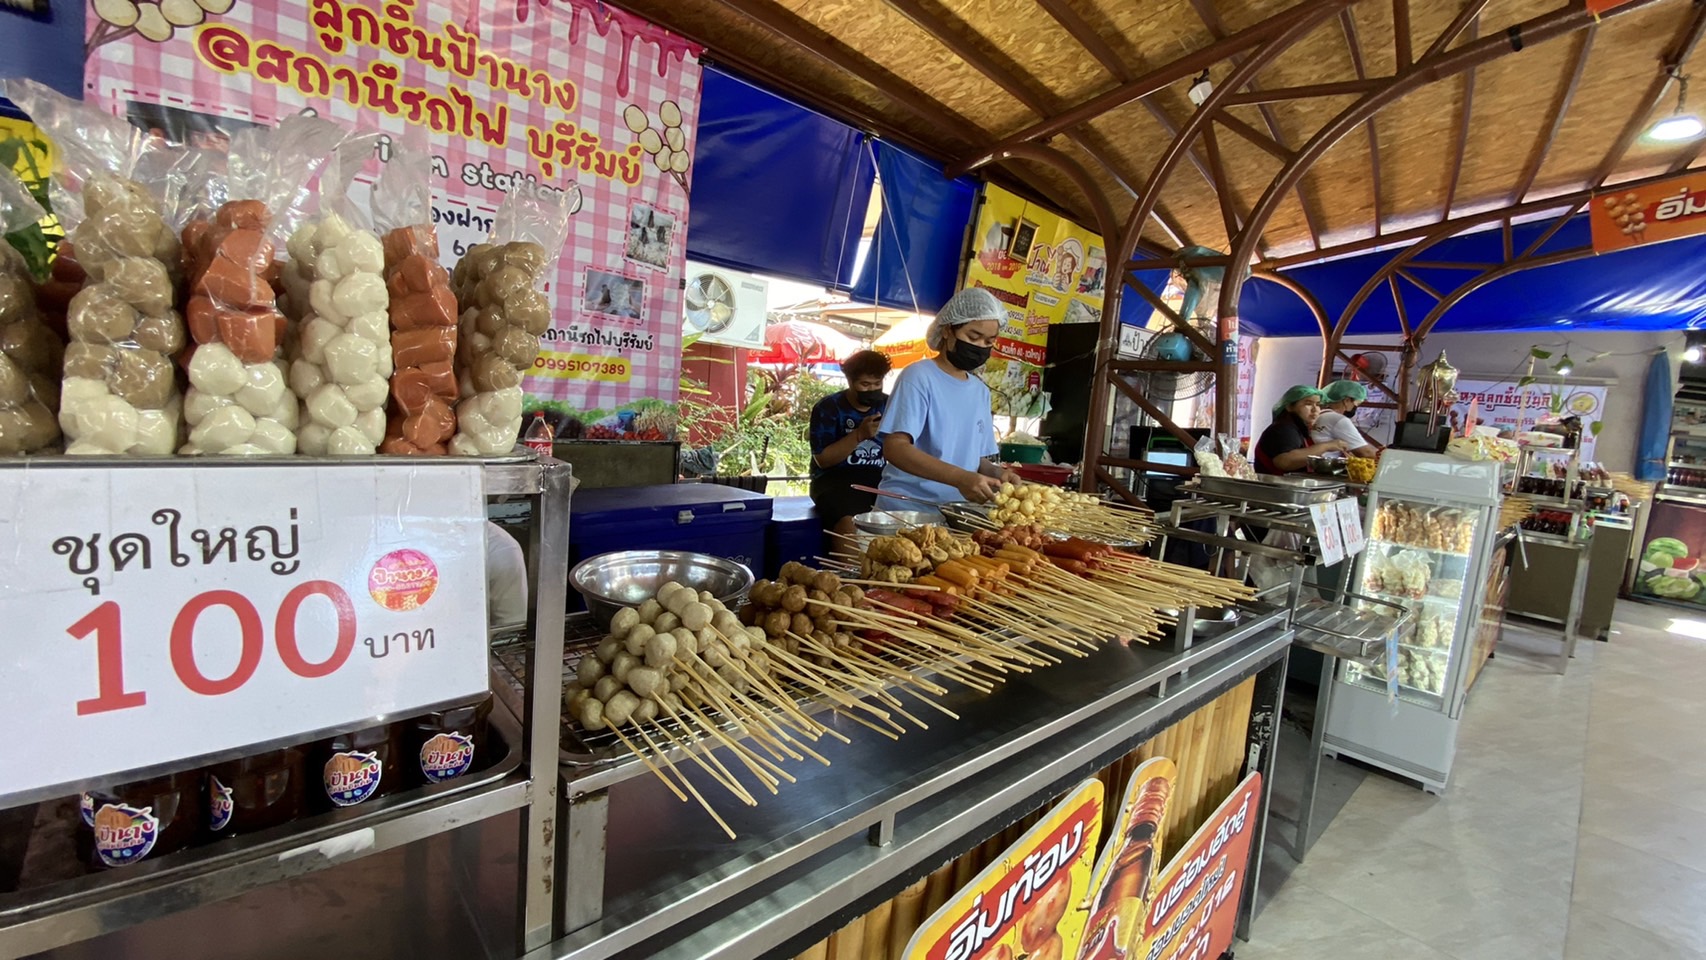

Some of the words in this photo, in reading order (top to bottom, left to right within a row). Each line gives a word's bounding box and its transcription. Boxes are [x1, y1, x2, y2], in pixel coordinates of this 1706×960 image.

[198, 27, 508, 146] @สถานีรถไฟ
[529, 123, 642, 184] บุรีรัมย์
[534, 356, 626, 376] 0995107389
[541, 325, 653, 353] ถานีรถไฟบุรีรัมย์
[52, 507, 301, 596] ชุดใหญ่
[66, 579, 357, 716] 100
[363, 626, 435, 659] บาท
[944, 819, 1084, 960] อิ่มท้อง
